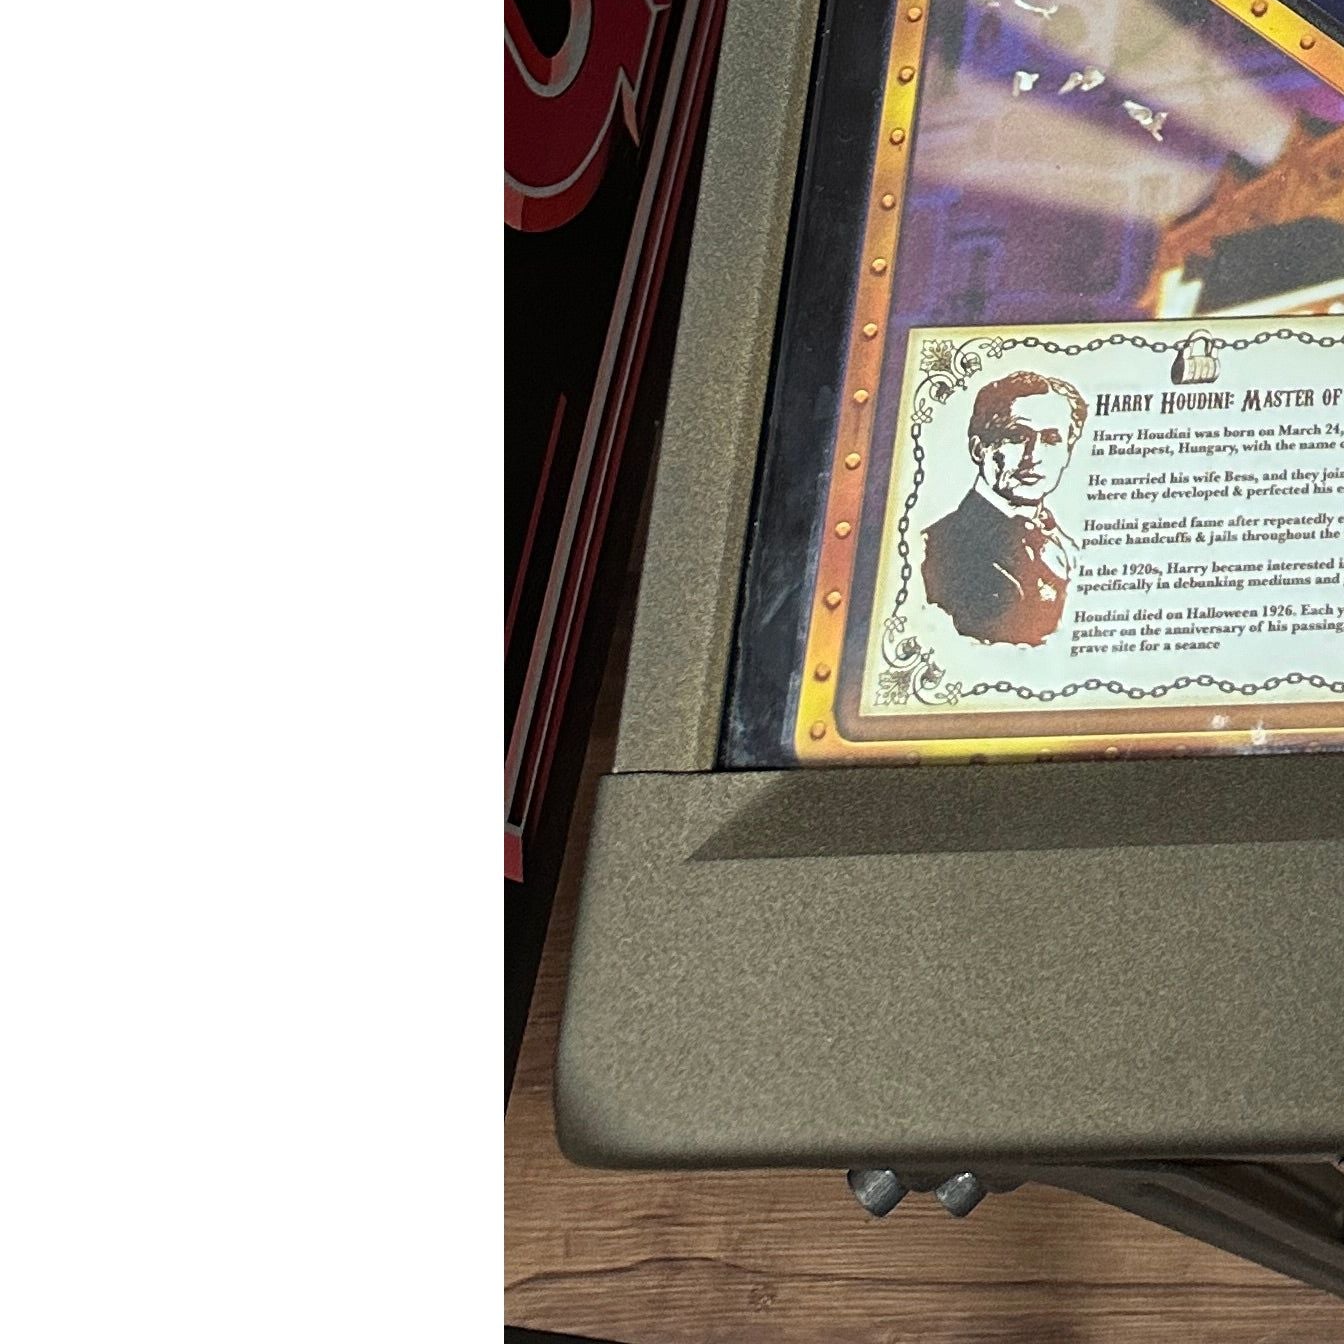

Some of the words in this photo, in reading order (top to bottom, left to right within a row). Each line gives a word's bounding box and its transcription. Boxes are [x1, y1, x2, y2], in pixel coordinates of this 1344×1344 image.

[1095, 394, 1154, 417] HARRY
[1160, 391, 1235, 415] HOUDINI:
[1238, 389, 1314, 413] MASTER
[1322, 388, 1343, 406] OF
[1093, 429, 1133, 442] Harry
[1136, 427, 1191, 439] Houdini
[1195, 430, 1220, 439] was
[1224, 426, 1255, 438] born
[1258, 429, 1275, 437] on
[1278, 424, 1321, 436] March
[1325, 423, 1344, 437] 24,
[1091, 444, 1105, 456] in
[1108, 444, 1174, 458] Budapest,
[1178, 442, 1239, 456] Hungary,
[1242, 440, 1272, 452] with
[1275, 440, 1296, 451] the
[1299, 441, 1336, 450] name
[1088, 474, 1107, 487] He
[1111, 472, 1166, 486] married
[1170, 472, 1189, 484] his
[1193, 471, 1221, 483] wife
[1224, 471, 1259, 484] Bess,
[1262, 469, 1287, 481] and
[1291, 469, 1318, 484] they
[1086, 489, 1127, 501] where
[1131, 488, 1159, 502] they
[1162, 485, 1229, 501] developed
[1232, 485, 1243, 496] &
[1246, 483, 1309, 500] perfected
[1313, 483, 1333, 494] his
[1083, 518, 1139, 532] Houdini
[1141, 517, 1187, 532] gained
[1190, 516, 1224, 528] fame
[1228, 515, 1260, 527] after
[1263, 513, 1334, 529] repeatedly
[1081, 534, 1122, 550] police
[1125, 532, 1192, 545] handcuffs
[1195, 532, 1206, 543] &
[1207, 530, 1238, 546] jails
[1242, 529, 1316, 544] throughout
[1320, 528, 1340, 539] the
[1079, 565, 1093, 577] In
[1097, 564, 1118, 577] the
[1122, 563, 1163, 577] 1920s,
[1166, 562, 1208, 576] Harry
[1212, 561, 1263, 574] became
[1267, 559, 1335, 571] interested
[1077, 578, 1153, 595] specifically
[1156, 578, 1170, 589] in
[1173, 576, 1245, 591] debunking
[1247, 575, 1311, 587] mediums
[1315, 574, 1340, 585] and
[1073, 609, 1130, 624] Houdini
[1133, 608, 1162, 621] died
[1166, 612, 1183, 620] on
[1187, 607, 1258, 619] Halloween
[1300, 604, 1334, 616] Each
